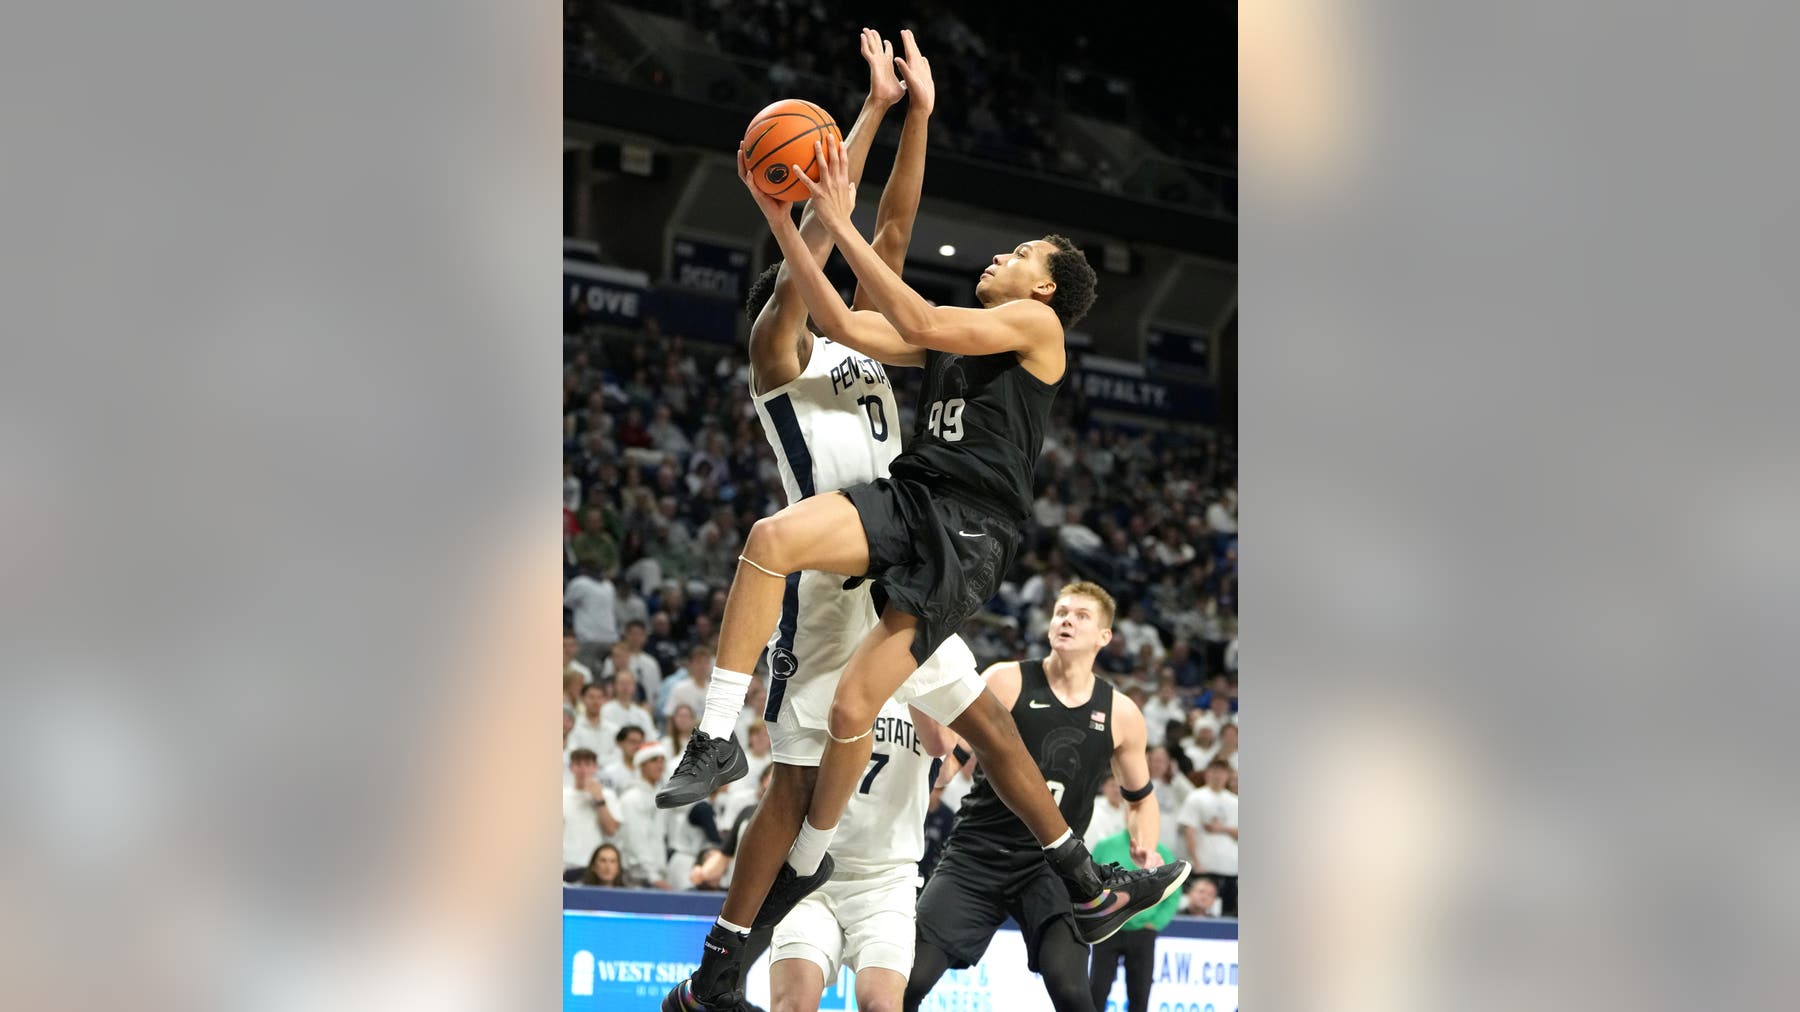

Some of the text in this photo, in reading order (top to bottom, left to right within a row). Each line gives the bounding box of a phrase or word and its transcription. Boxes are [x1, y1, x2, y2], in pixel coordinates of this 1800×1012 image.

[928, 398, 966, 442] 99
[875, 717, 921, 757] STATE
[859, 752, 890, 794] 7
[598, 960, 701, 984] WEST SHO
[1154, 951, 1238, 985] AW.com
